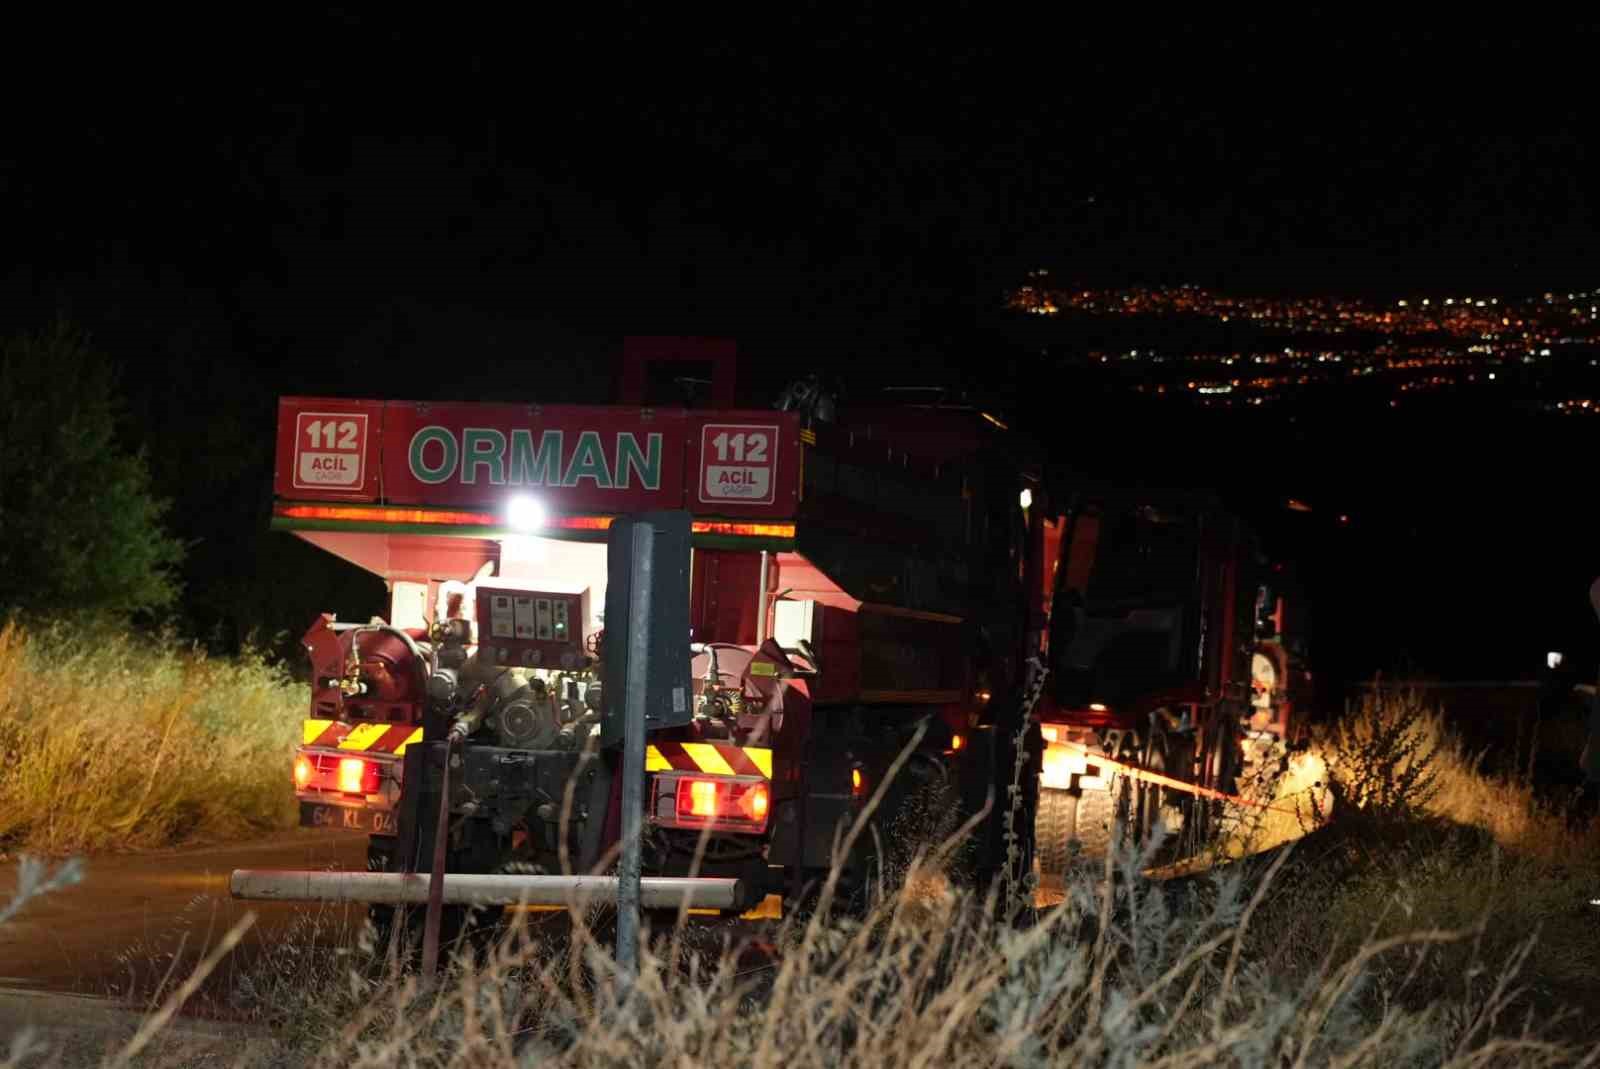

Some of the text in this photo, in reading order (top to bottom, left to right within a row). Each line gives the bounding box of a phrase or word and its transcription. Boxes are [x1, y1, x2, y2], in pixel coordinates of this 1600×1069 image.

[306, 420, 359, 449] 112
[408, 425, 663, 490] ORMAN
[712, 432, 768, 462] 112
[311, 455, 348, 471] ACİL
[718, 468, 758, 485] ACİL
[343, 808, 362, 828] KL
